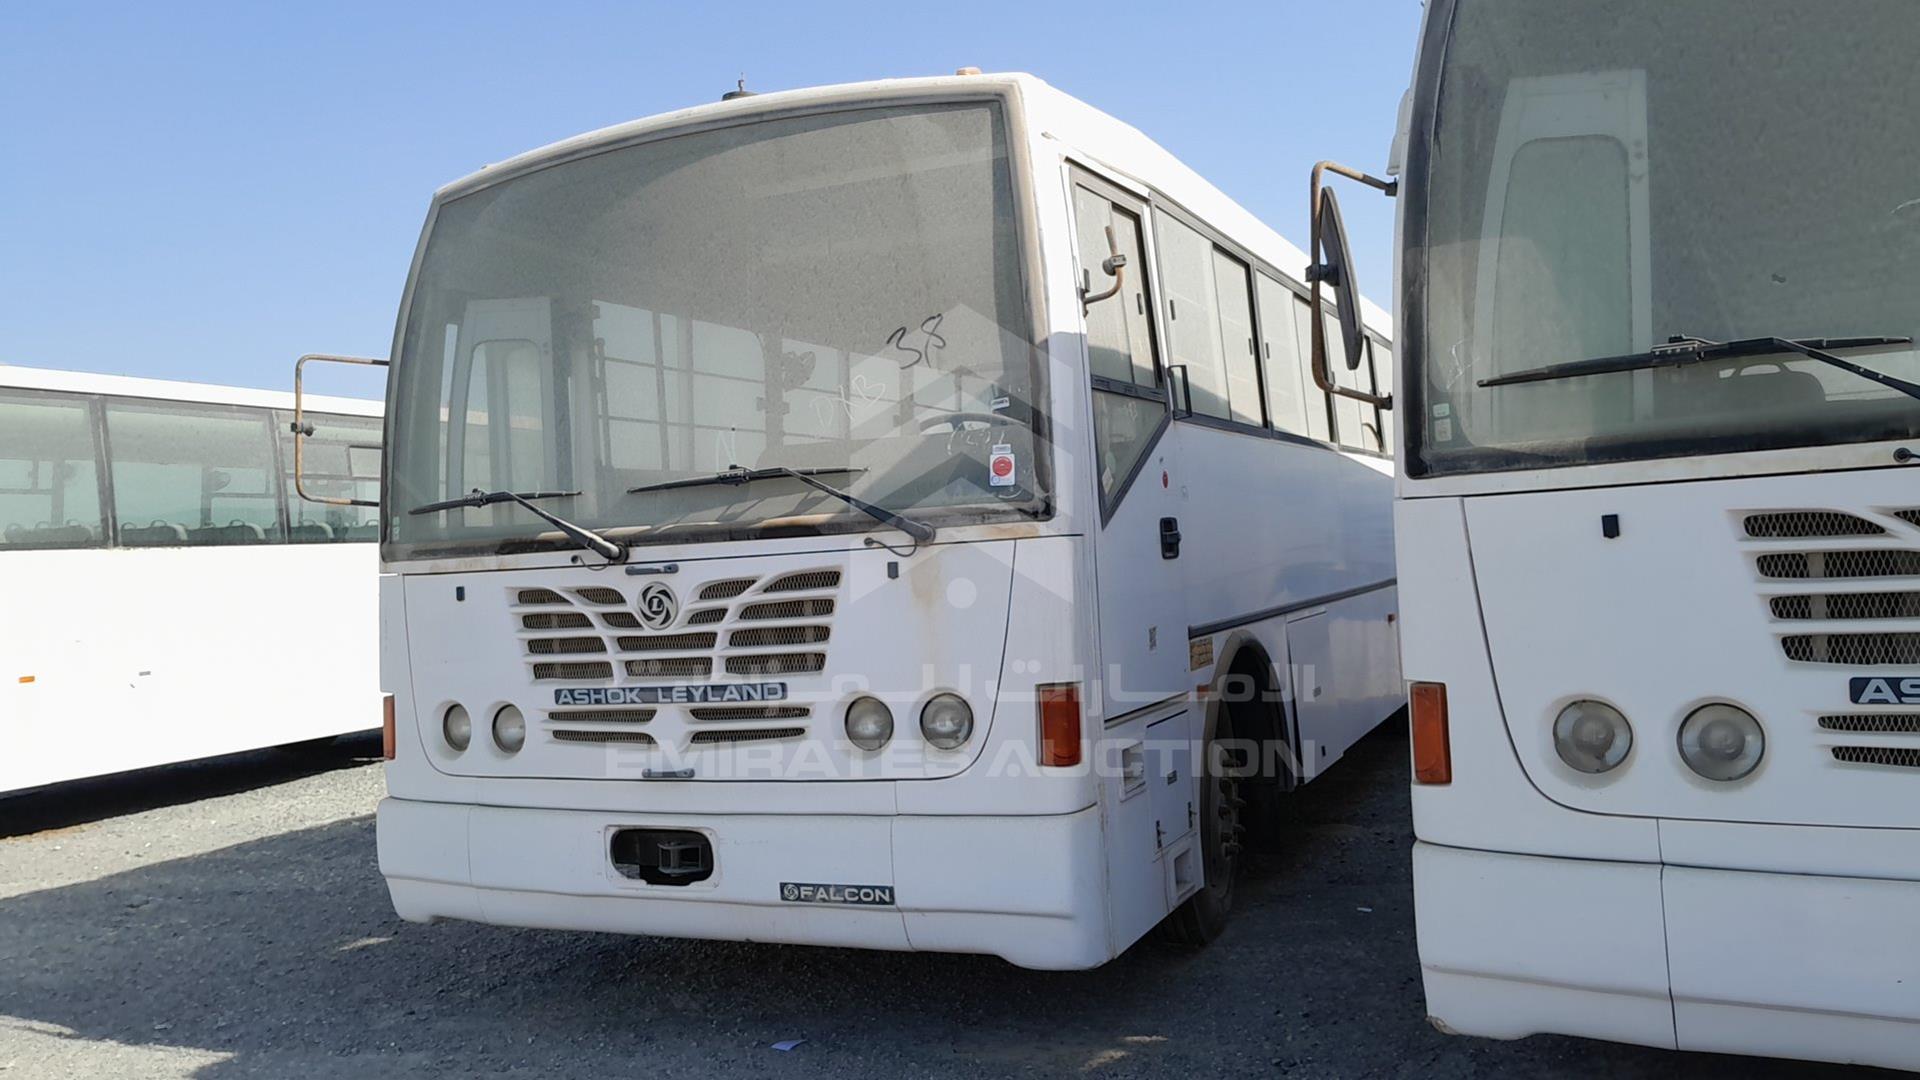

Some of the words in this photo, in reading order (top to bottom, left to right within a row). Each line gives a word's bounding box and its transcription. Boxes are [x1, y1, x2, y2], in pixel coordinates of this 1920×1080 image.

[886, 313, 946, 369] 38
[557, 688, 642, 705] ASHOK
[657, 683, 784, 703] LEYLAND
[800, 886, 890, 902] FALCON
